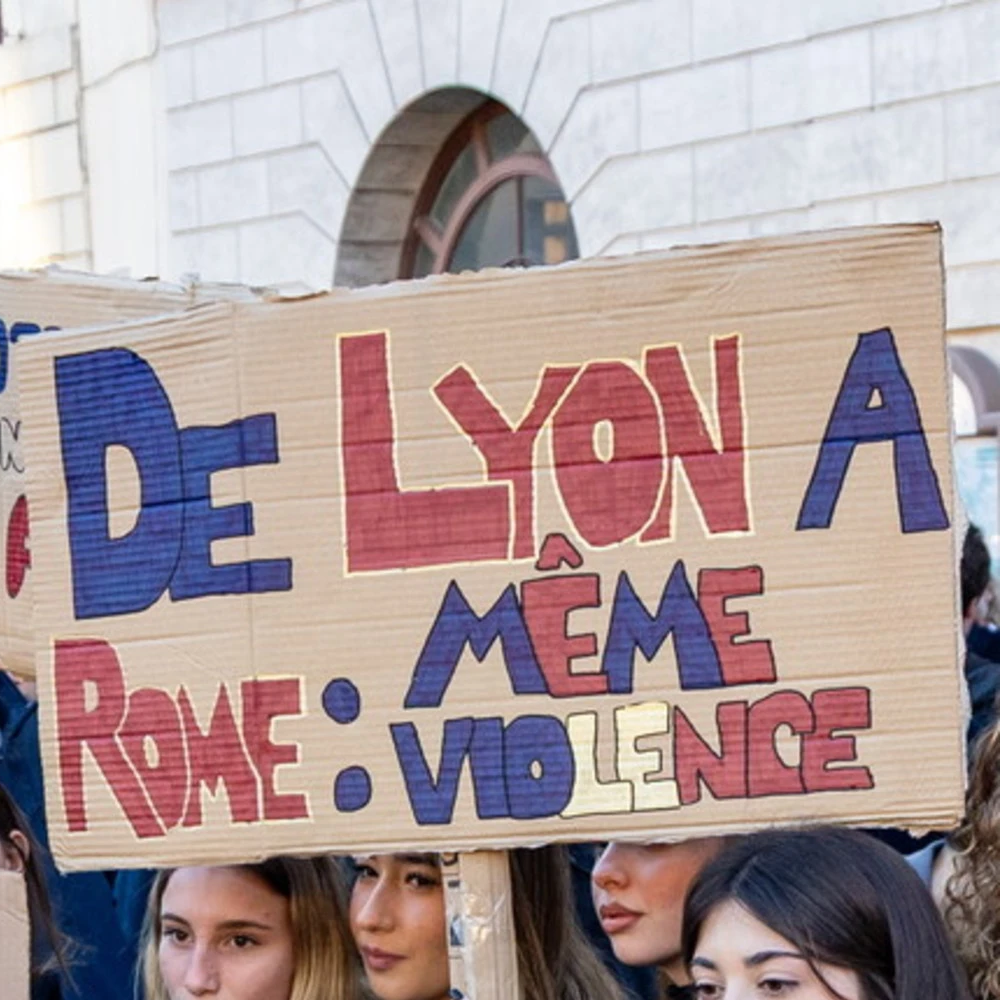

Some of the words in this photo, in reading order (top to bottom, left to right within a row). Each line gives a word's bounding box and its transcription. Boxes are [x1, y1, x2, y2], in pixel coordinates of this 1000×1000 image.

[53, 346, 293, 621] DE
[336, 330, 755, 577] LYON
[795, 326, 949, 533] A
[404, 533, 777, 709] MÊME
[389, 687, 874, 826] VIOLENCE
